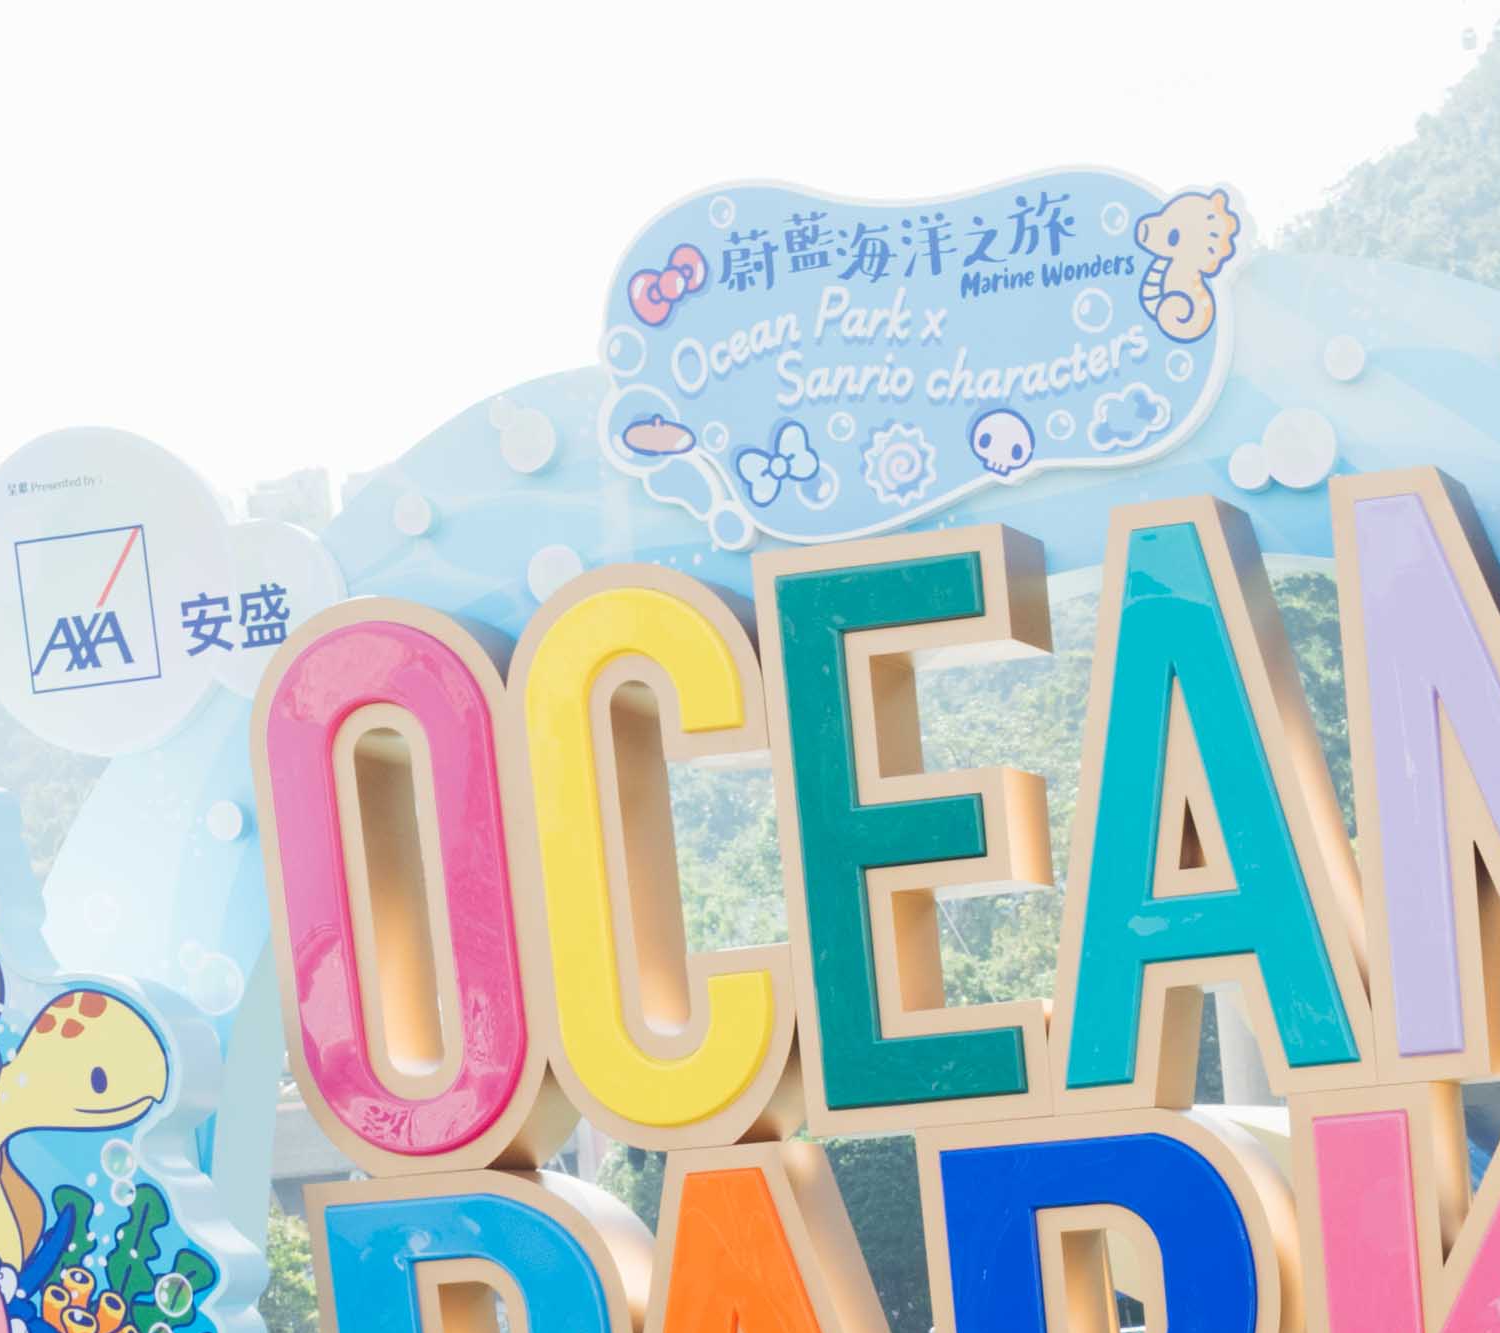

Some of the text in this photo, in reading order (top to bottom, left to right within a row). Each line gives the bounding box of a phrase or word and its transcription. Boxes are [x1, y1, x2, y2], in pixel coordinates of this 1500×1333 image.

[718, 191, 1076, 293] 蔚藍海洋之旅
[960, 253, 1137, 299] Marine Wonders
[671, 310, 801, 393] Ocean
[813, 285, 910, 342] Park
[775, 324, 1150, 406] Sanrio characters
[32, 611, 134, 676] AXA
[180, 583, 291, 657] 安盛
